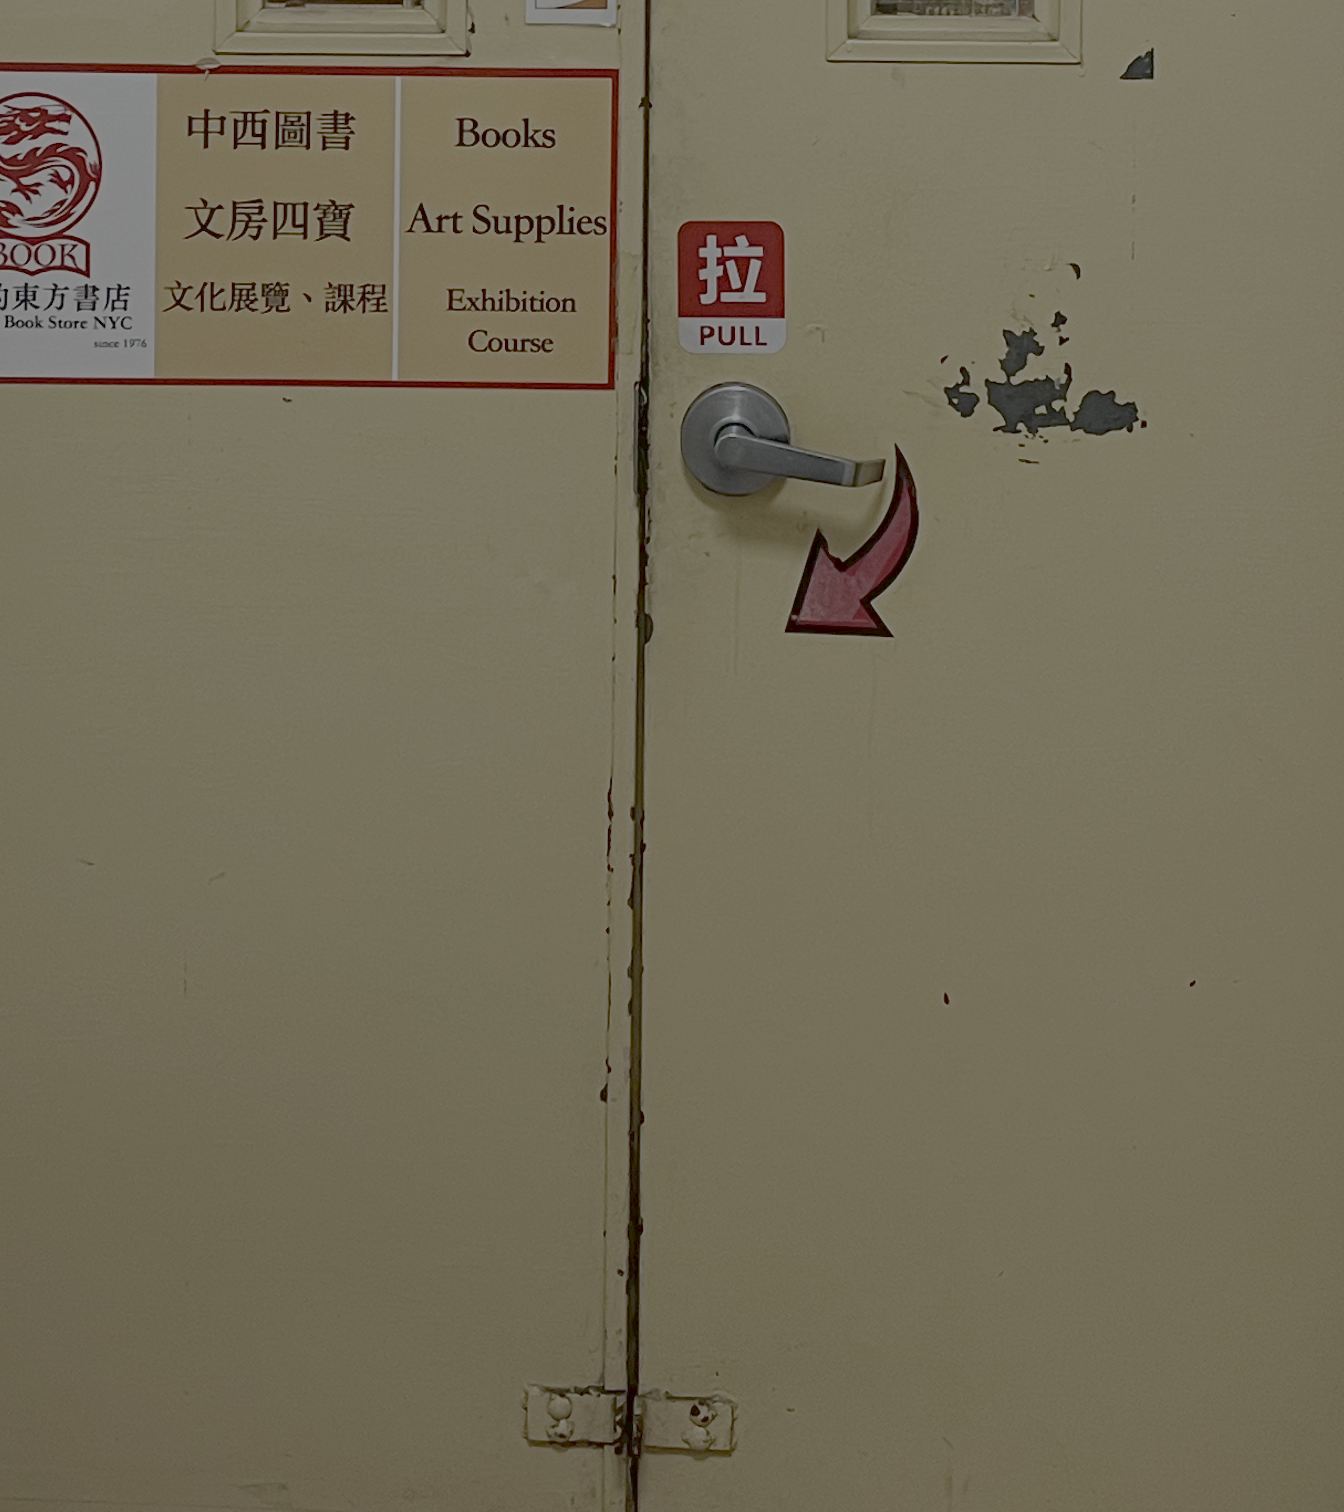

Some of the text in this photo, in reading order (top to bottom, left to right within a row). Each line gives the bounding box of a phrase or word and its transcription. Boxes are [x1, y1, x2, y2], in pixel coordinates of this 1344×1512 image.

[186, 108, 356, 151] 中西圖書
[455, 117, 556, 149] Books
[182, 197, 355, 242] 文房四寶
[405, 202, 608, 244] Art Supplies
[698, 234, 767, 305] 拉
[161, 279, 389, 315] 文化展覽、課程
[446, 288, 578, 313] Exhibition
[4, 315, 44, 329] Book
[48, 316, 88, 330] Store
[93, 316, 133, 330] NYC
[700, 325, 768, 346] PULL
[93, 338, 148, 348] since 1976
[467, 329, 555, 354] Course
